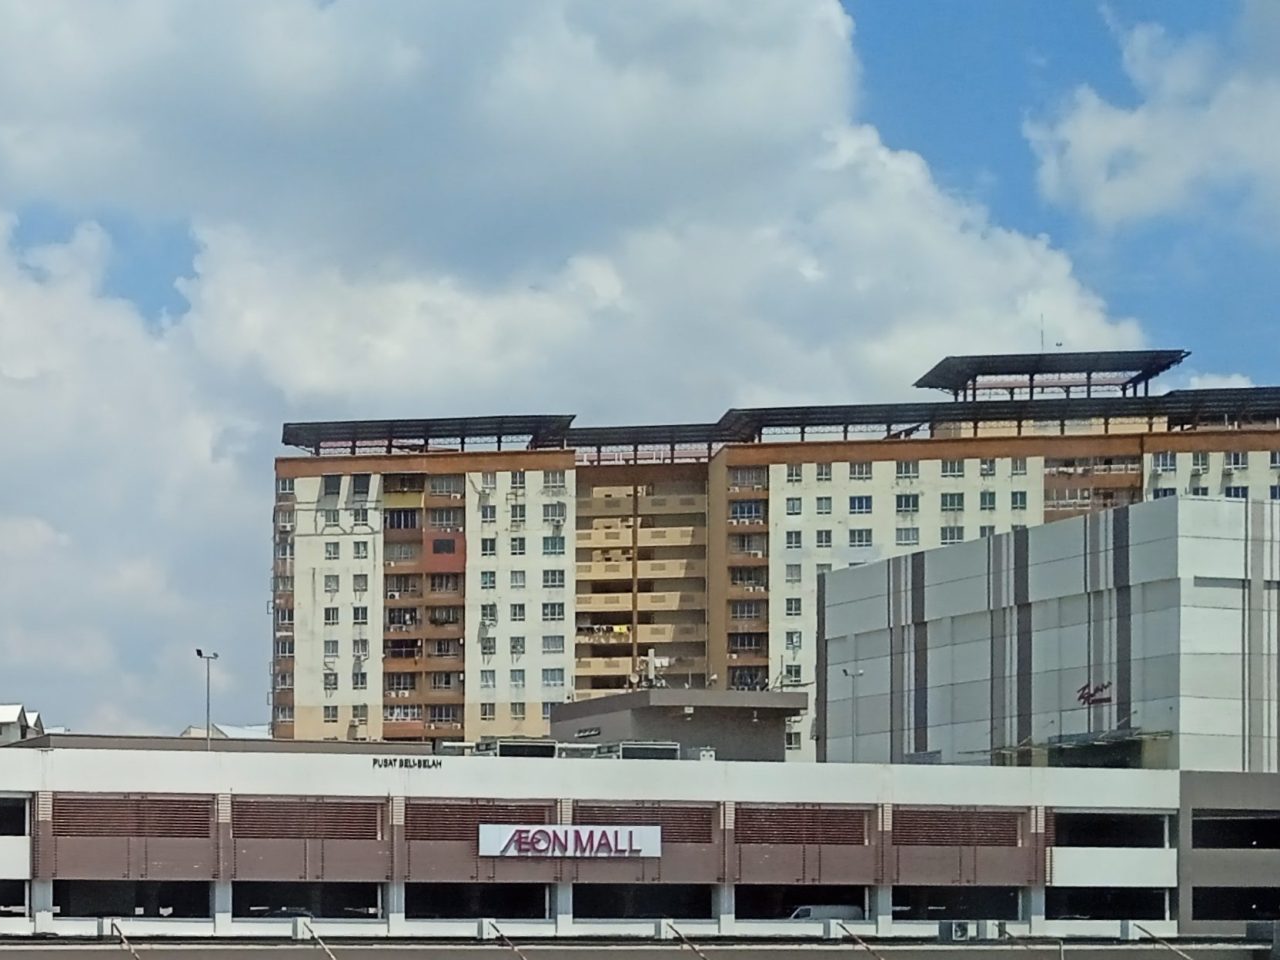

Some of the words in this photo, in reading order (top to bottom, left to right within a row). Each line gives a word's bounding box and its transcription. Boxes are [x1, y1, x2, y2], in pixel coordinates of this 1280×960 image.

[372, 758, 397, 769] PUSAT
[399, 758, 442, 769] BELI-BELAH
[574, 830, 641, 854] MALL
